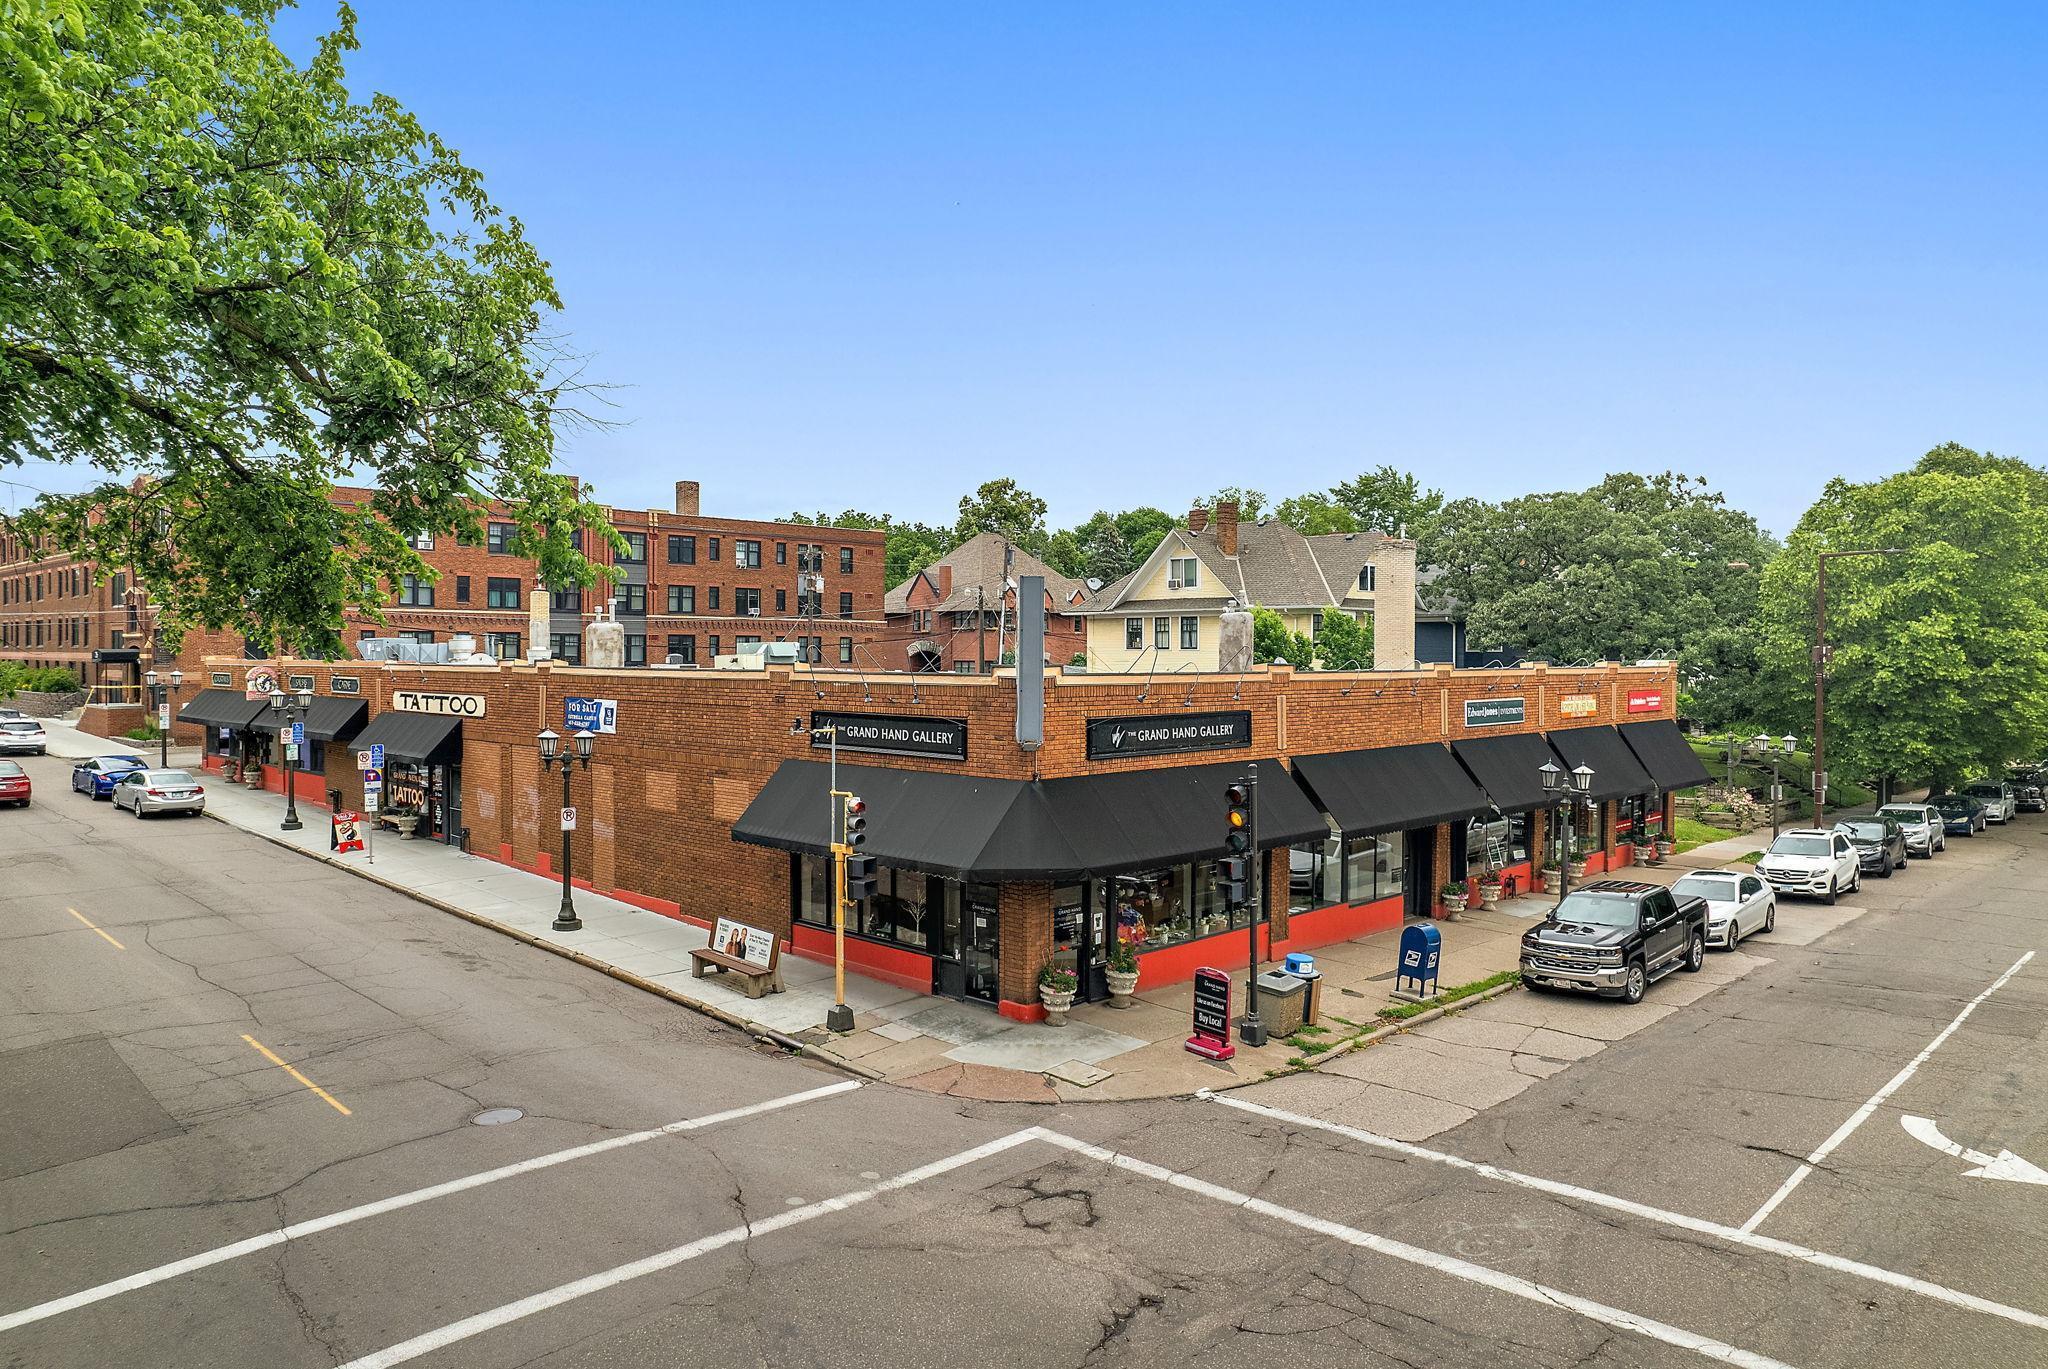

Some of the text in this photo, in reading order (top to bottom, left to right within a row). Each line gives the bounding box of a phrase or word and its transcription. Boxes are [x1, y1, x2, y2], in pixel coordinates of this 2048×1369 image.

[399, 693, 478, 714] TATTOO
[568, 702, 597, 713] FOR SALE
[847, 726, 878, 739] GRAND
[881, 728, 909, 741] HAND
[912, 730, 954, 745] GALLERY
[1138, 729, 1169, 742] GRAND
[1172, 726, 1198, 739] HAND
[1200, 724, 1234, 738] GALLERY
[392, 785, 424, 806] TATTOO
[1058, 908, 1071, 916] GRAND
[1199, 1013, 1221, 1027] Buy Local
